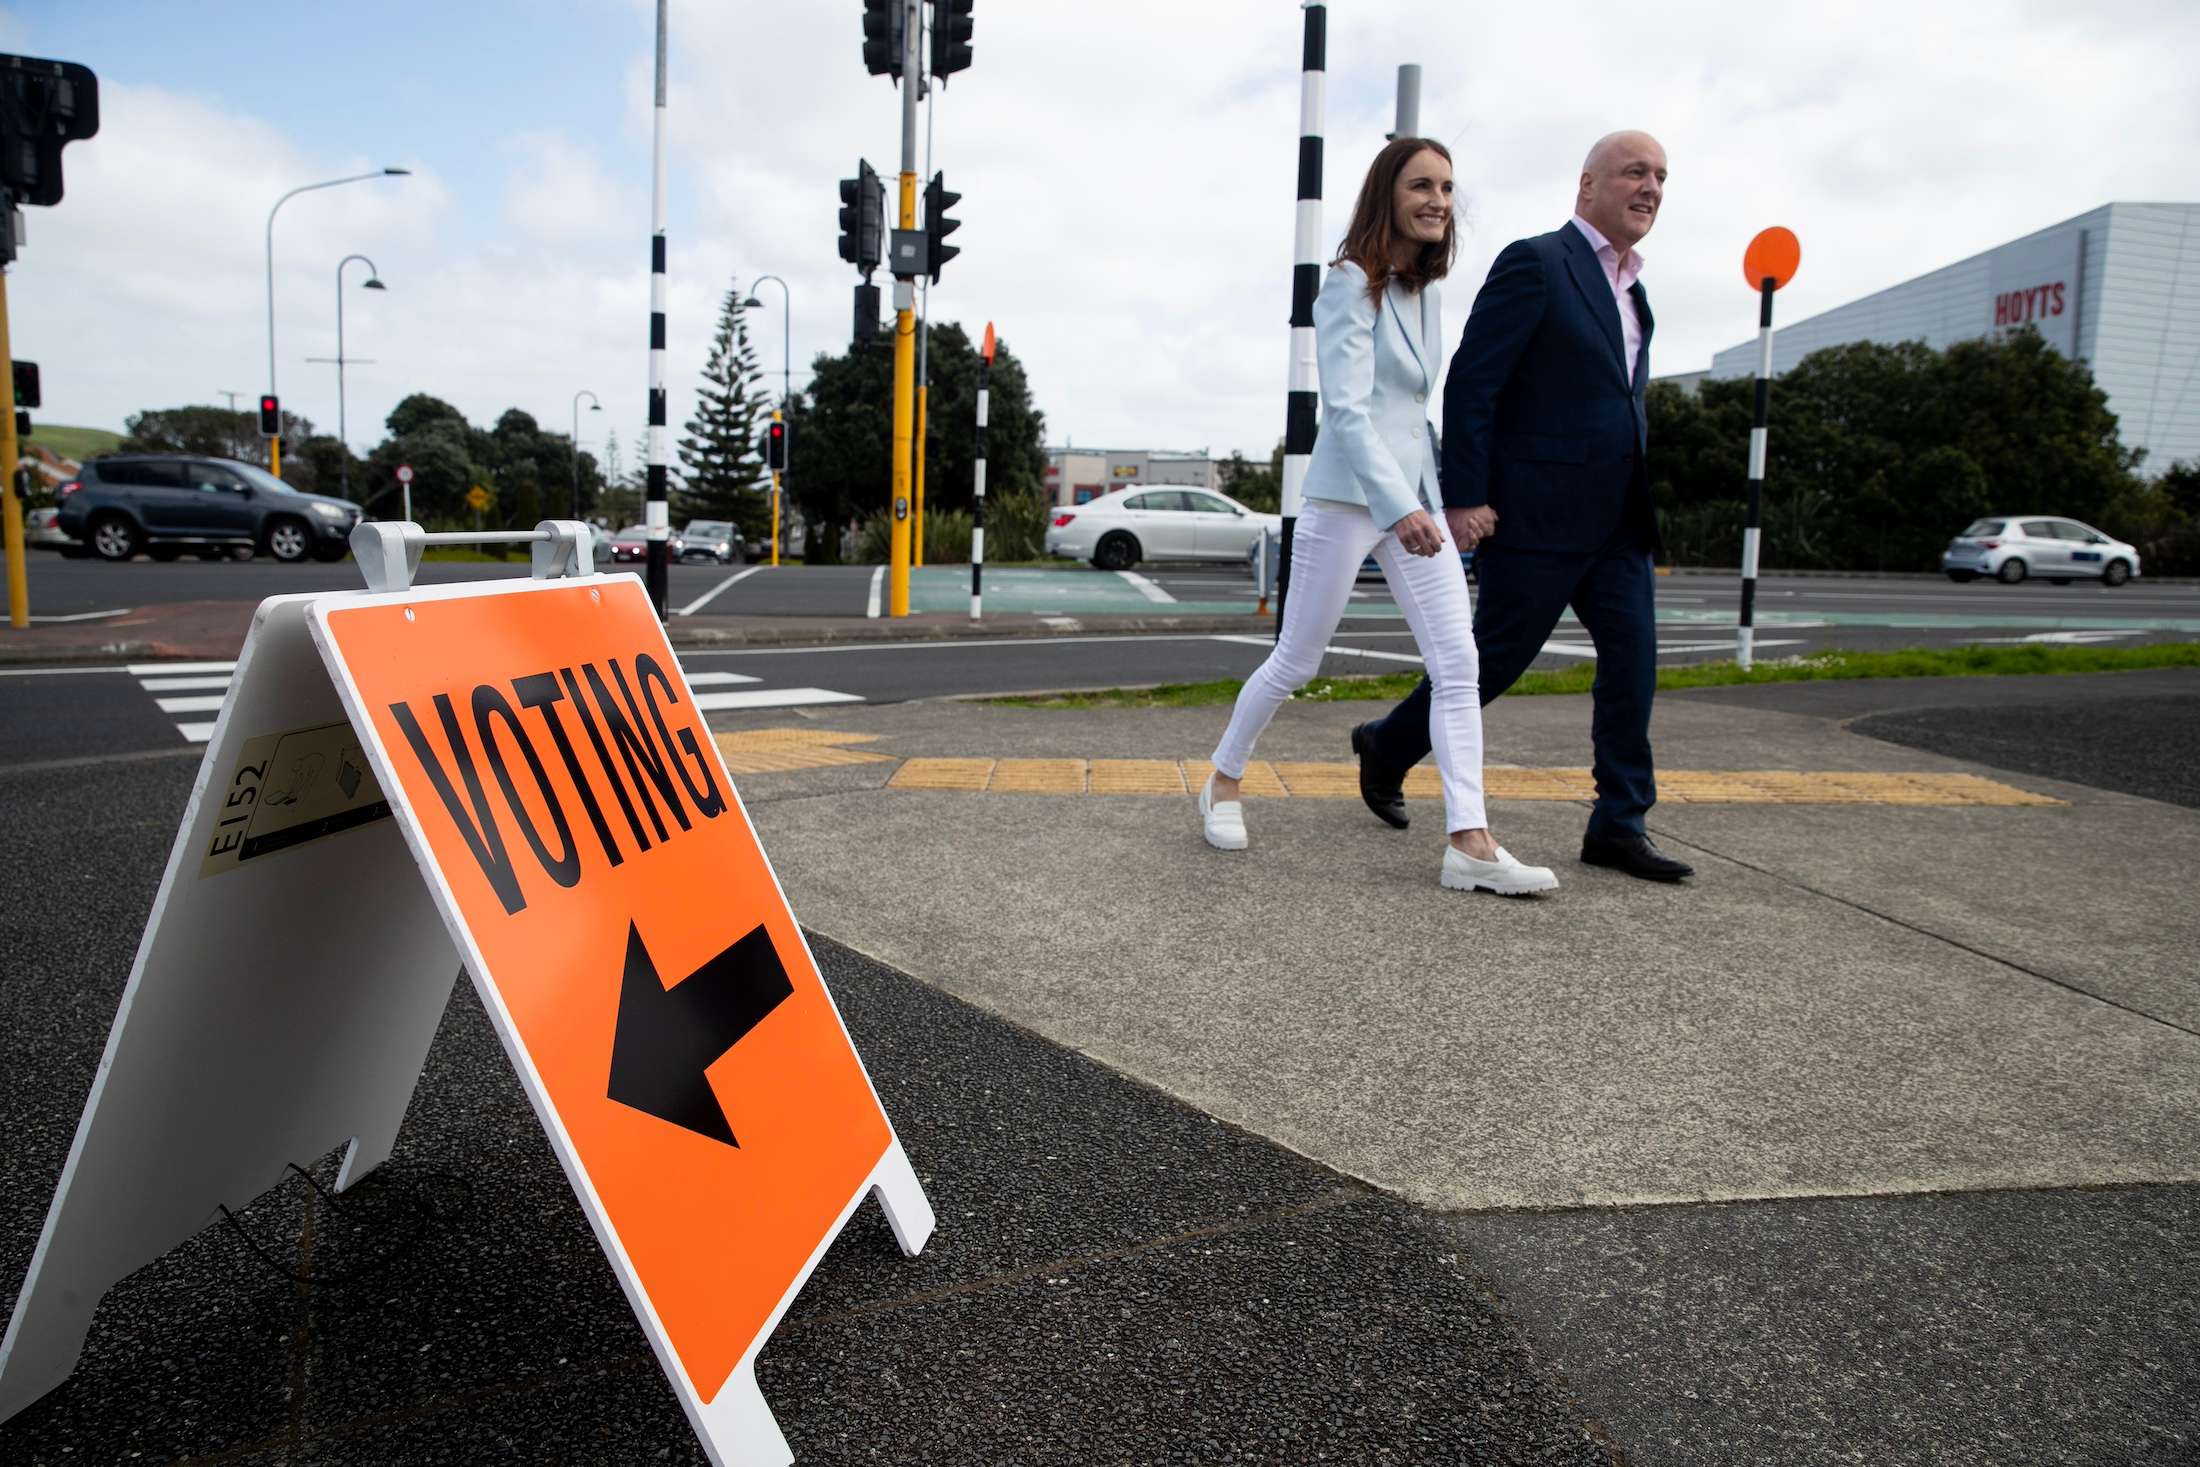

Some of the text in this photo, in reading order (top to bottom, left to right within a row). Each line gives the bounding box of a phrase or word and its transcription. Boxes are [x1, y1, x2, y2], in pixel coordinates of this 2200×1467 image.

[1995, 281, 2065, 326] HOYTS
[209, 760, 268, 857] E152
[388, 652, 728, 916] VOTING
